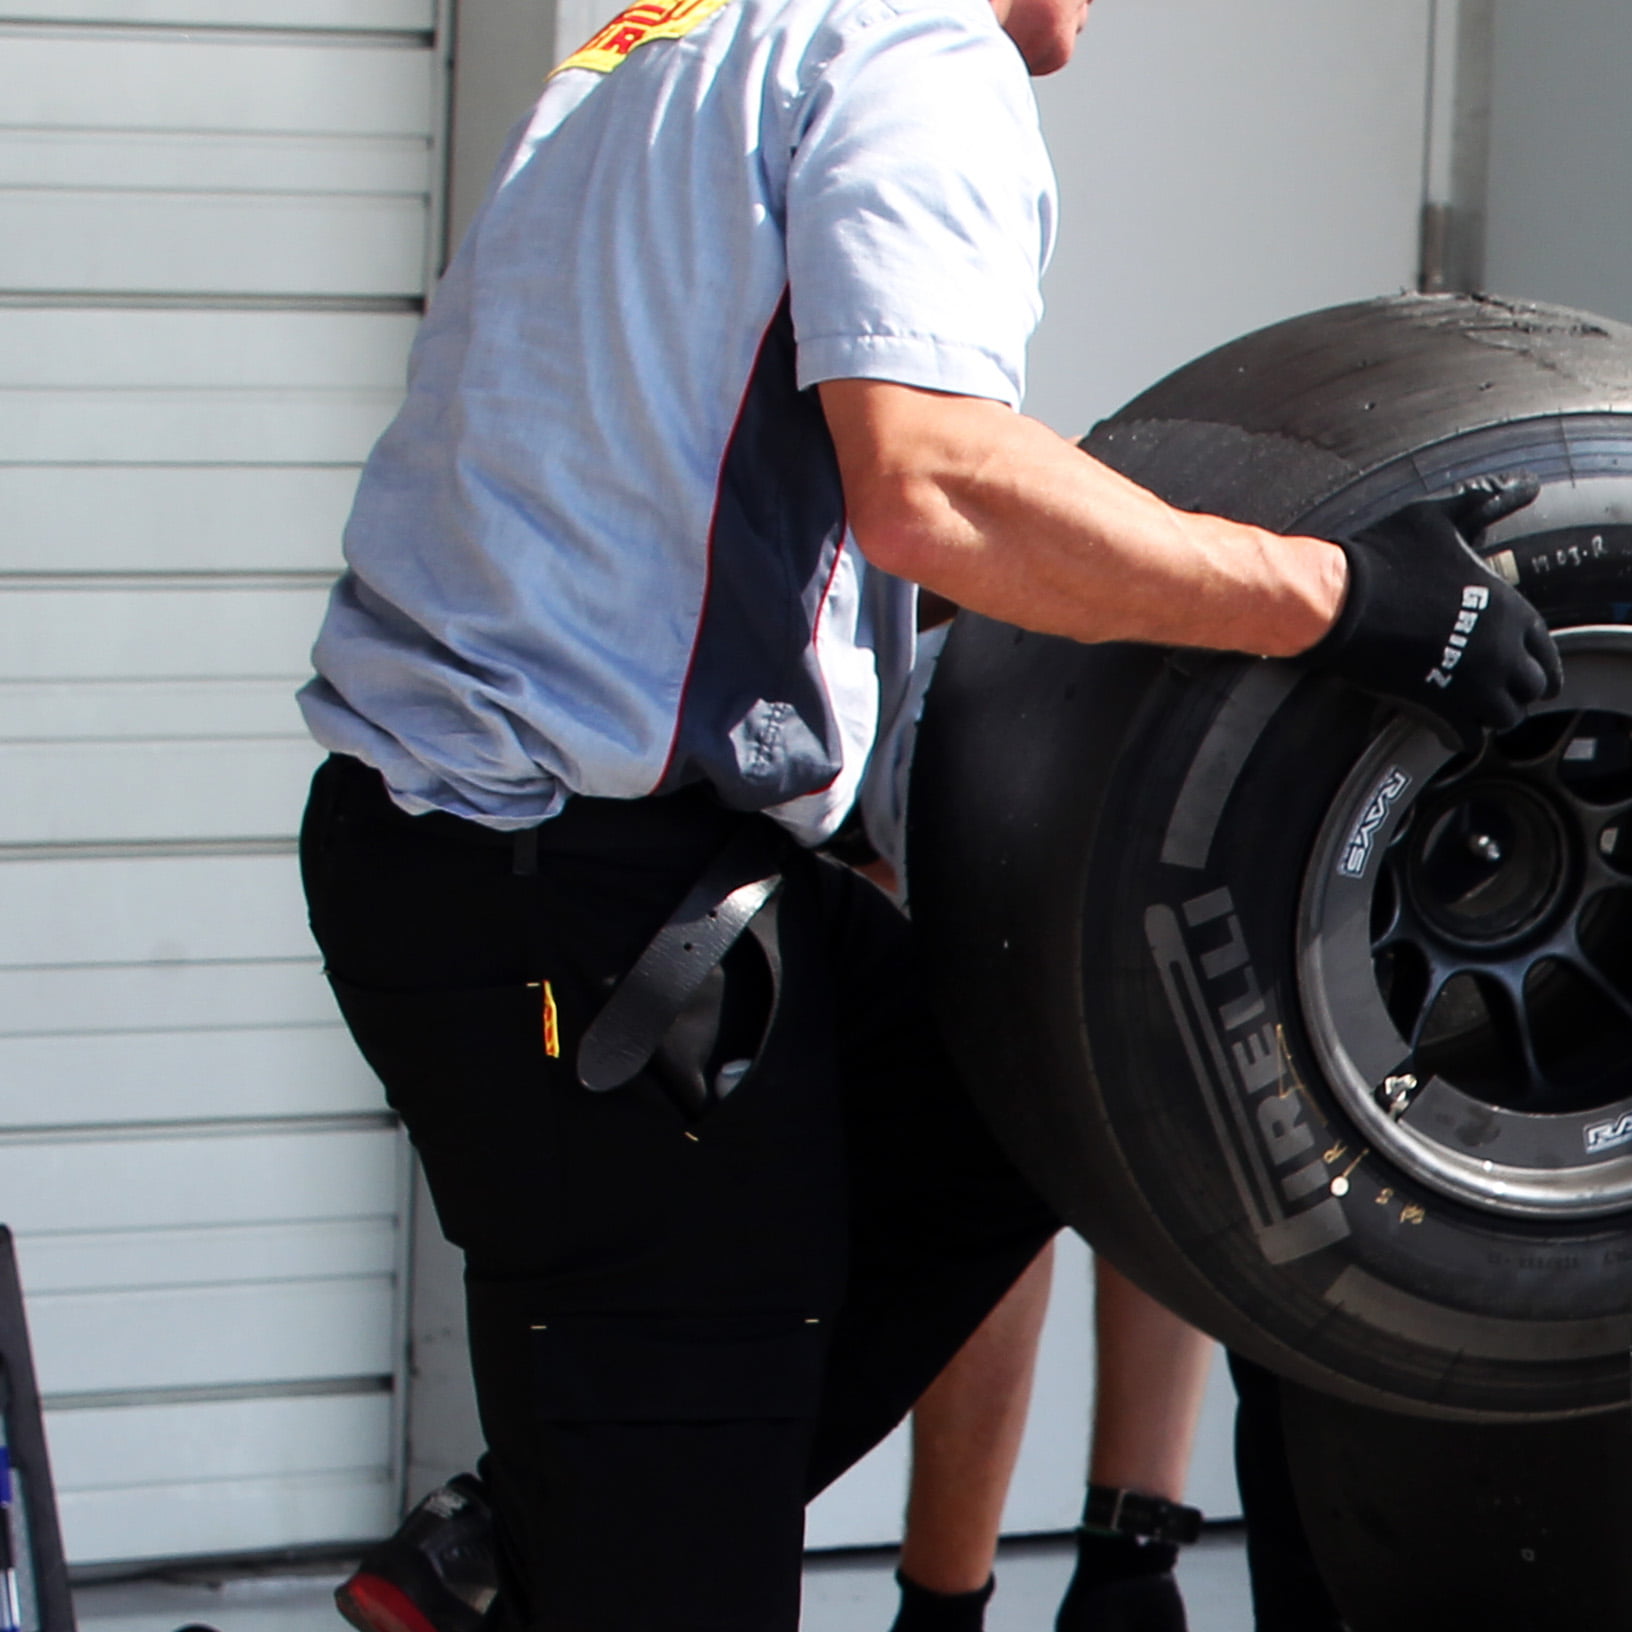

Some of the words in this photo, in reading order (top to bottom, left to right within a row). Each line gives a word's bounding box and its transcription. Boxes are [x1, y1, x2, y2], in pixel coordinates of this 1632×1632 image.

[1425, 585, 1489, 688] GRIPZ
[1342, 768, 1408, 875] RAYS
[1145, 886, 1351, 1264] PIRELLI
